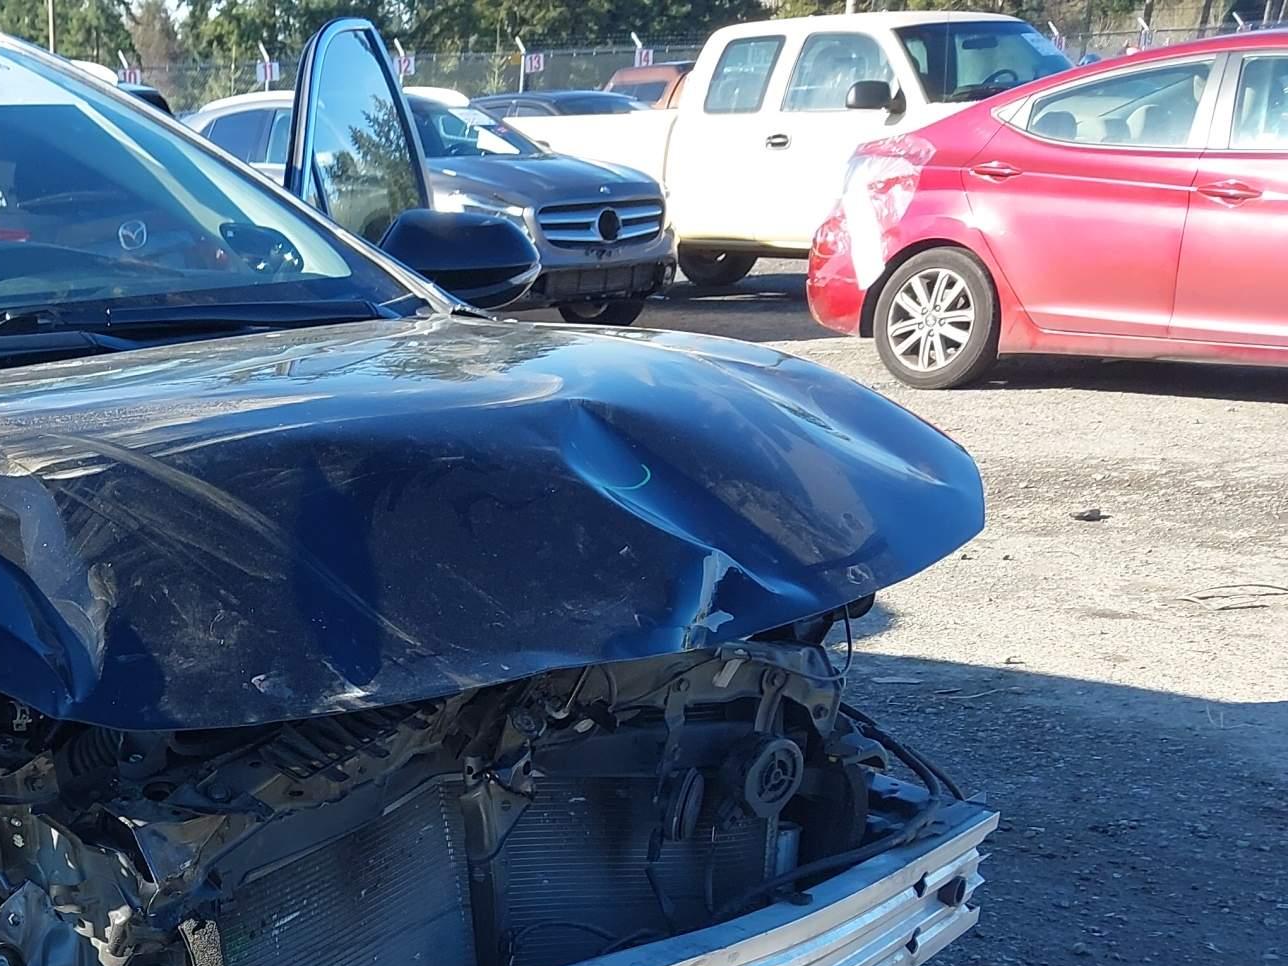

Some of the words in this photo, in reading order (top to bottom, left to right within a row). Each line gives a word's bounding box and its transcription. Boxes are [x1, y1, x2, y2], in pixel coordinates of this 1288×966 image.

[398, 58, 411, 73] 12
[529, 55, 542, 71] 13
[639, 51, 650, 66] 14
